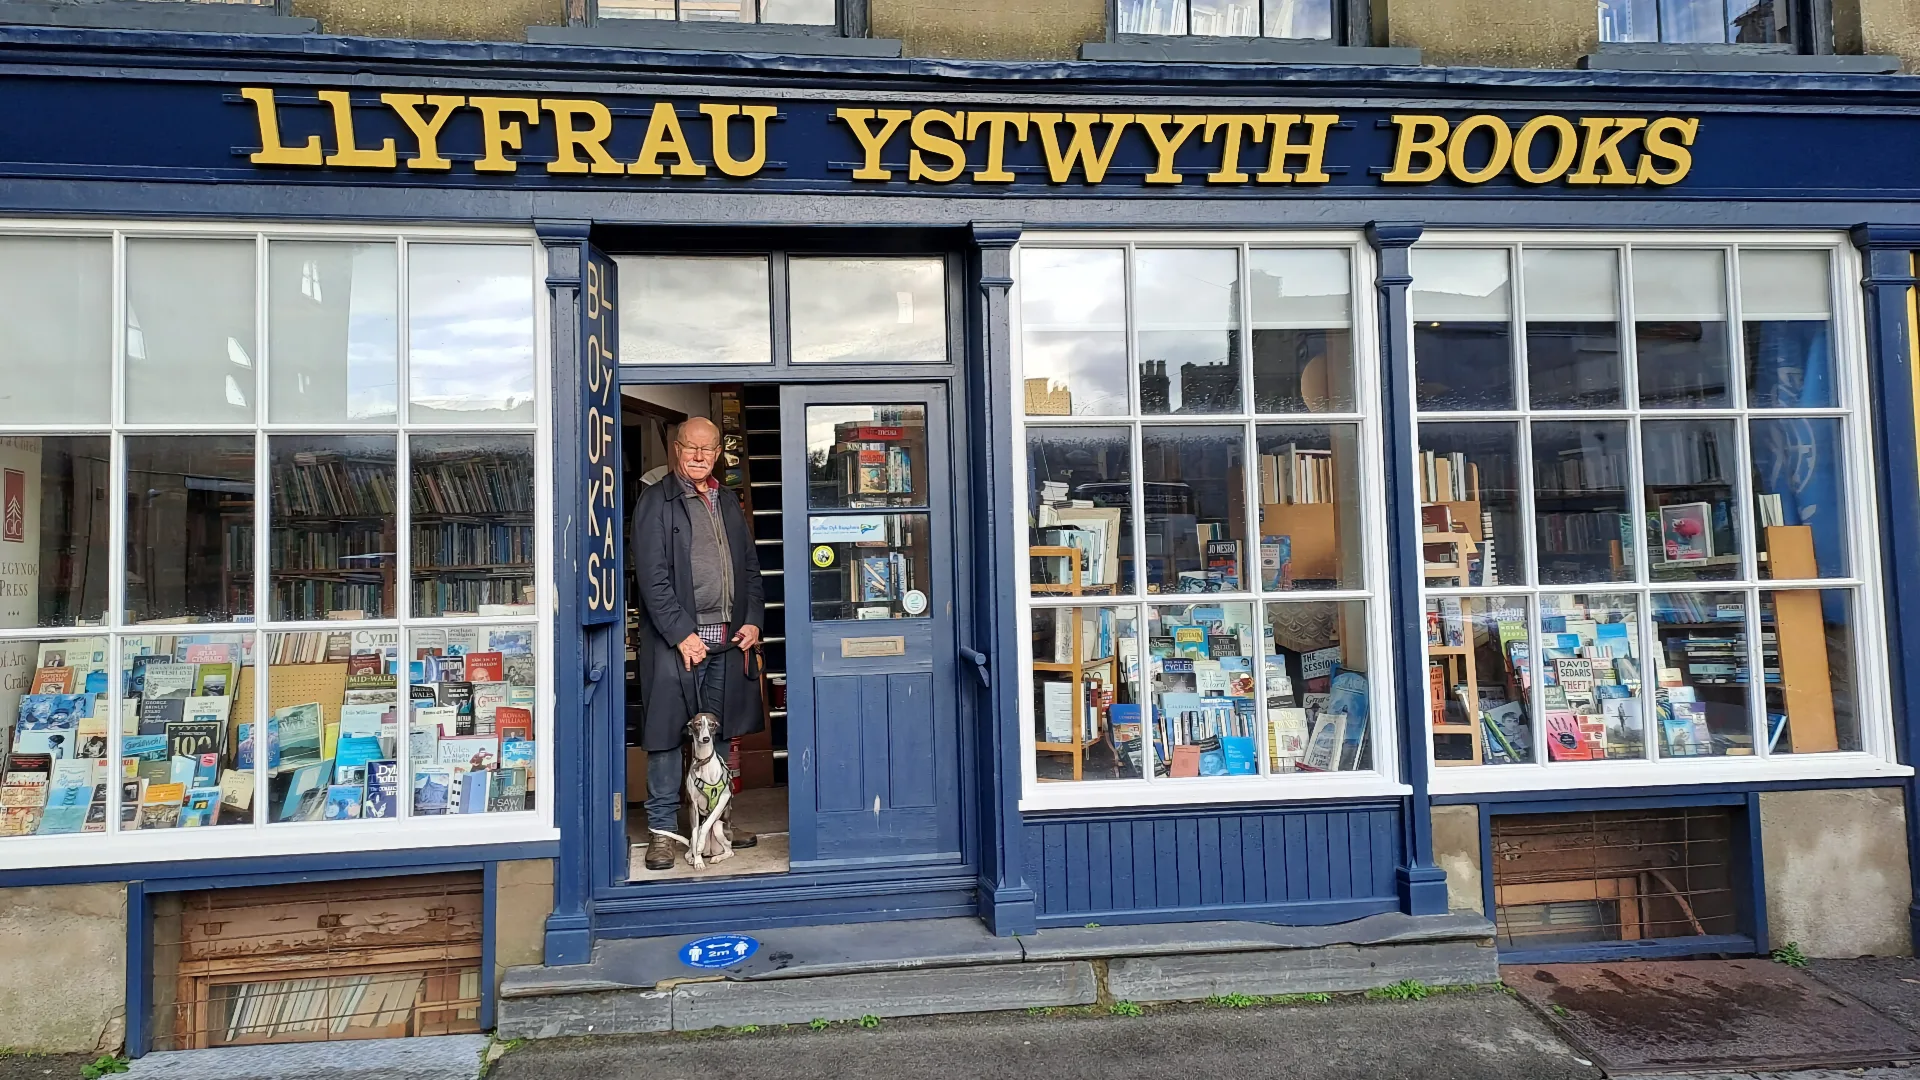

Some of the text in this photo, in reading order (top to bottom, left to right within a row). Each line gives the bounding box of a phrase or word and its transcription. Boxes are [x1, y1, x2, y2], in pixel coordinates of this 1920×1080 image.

[241, 88, 1700, 187] LLYFRAU YSTWYTH BOOKS
[587, 260, 600, 611] BOOKS
[1208, 544, 1216, 554] JO
[0, 561, 38, 577] EGYNOG
[1302, 650, 1316, 662] THE
[1303, 658, 1341, 673] SESSIONS
[1559, 660, 1590, 668] DAVID
[1560, 668, 1592, 677] SEDARIS
[349, 675, 396, 683] MID-WALES
[1562, 680, 1588, 690] THEFT
[411, 691, 434, 699] WALES
[496, 798, 520, 807] SAW
[708, 950, 730, 958] 2m
